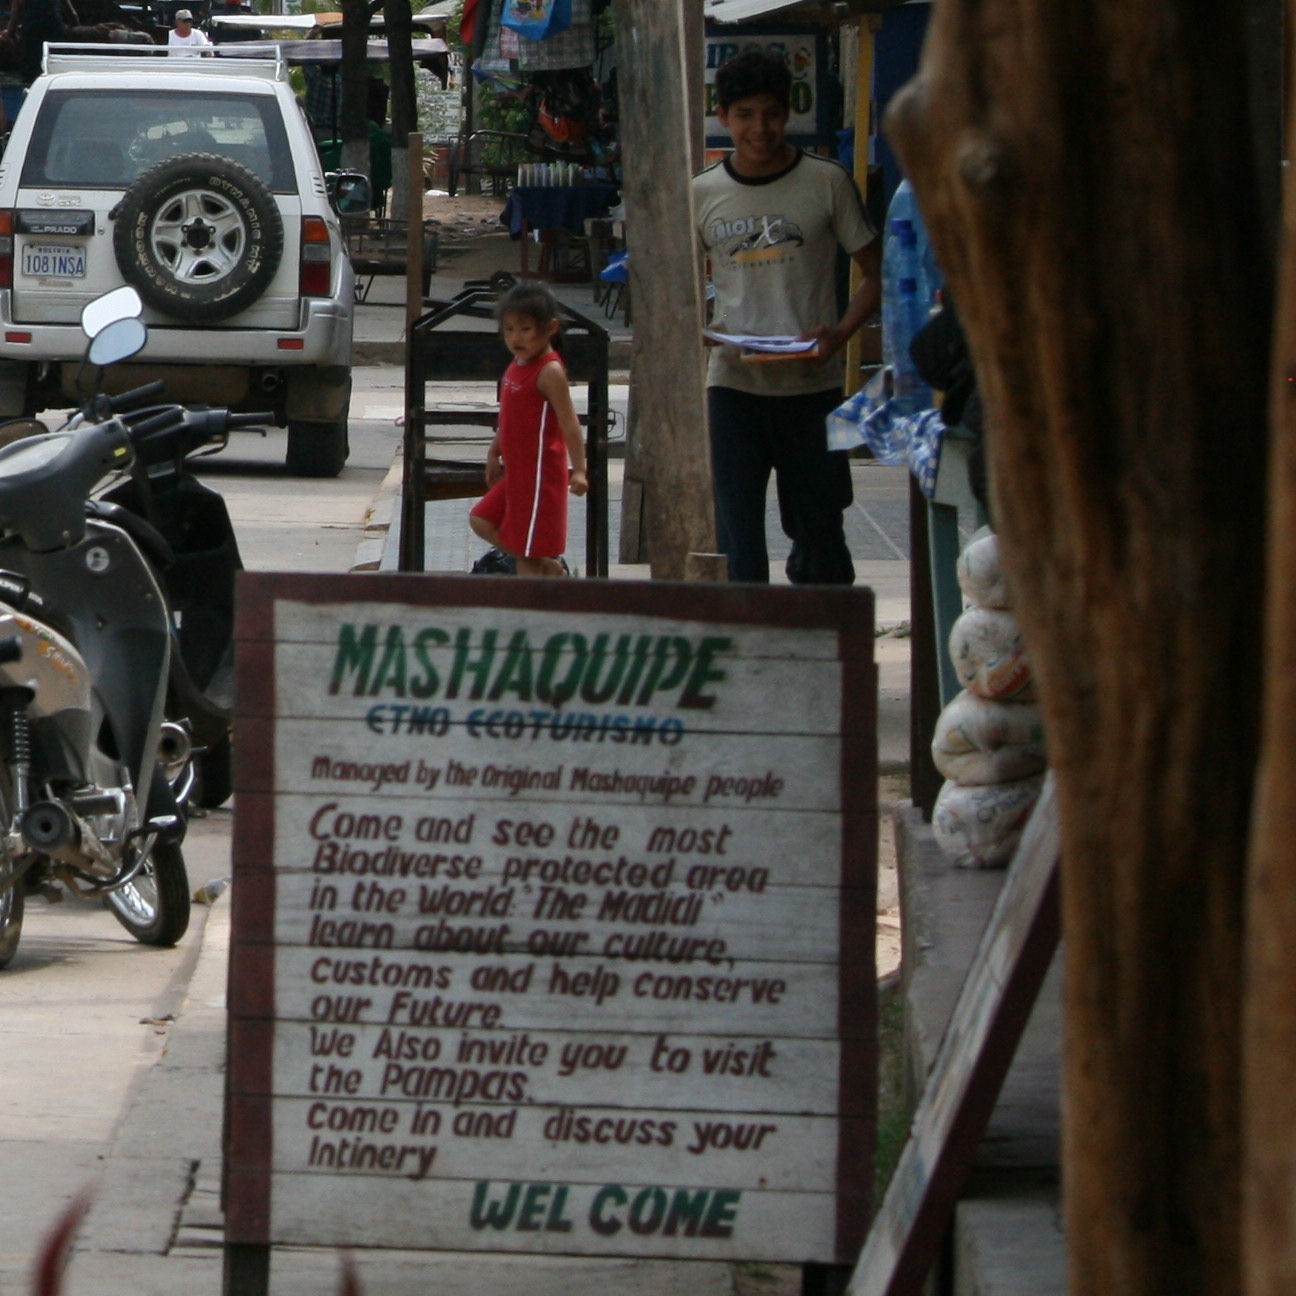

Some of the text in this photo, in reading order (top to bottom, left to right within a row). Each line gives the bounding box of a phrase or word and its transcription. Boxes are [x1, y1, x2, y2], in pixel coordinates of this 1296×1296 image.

[44, 225, 77, 234] PRADO
[328, 623, 732, 709] MASHAQUIPE
[466, 708, 684, 746] ECOTURISMO
[312, 756, 785, 802] Managed by the Original Mashaquipe people
[310, 803, 733, 855] Come and see the most
[312, 842, 770, 894] Biodiverse protected area
[310, 878, 338, 911] in
[351, 880, 406, 914] the
[310, 914, 395, 949] learn
[412, 918, 511, 954] about
[527, 929, 590, 957] our
[470, 963, 535, 993] and
[548, 961, 620, 1006] help
[633, 971, 787, 1004] conserve
[311, 995, 373, 1024] our
[310, 1026, 778, 1078] We Also invite you to visit
[310, 1063, 363, 1095] the
[452, 1108, 518, 1139] and
[543, 1106, 677, 1146] discuss
[686, 1120, 778, 1156] your
[308, 1135, 439, 1182] Intinery
